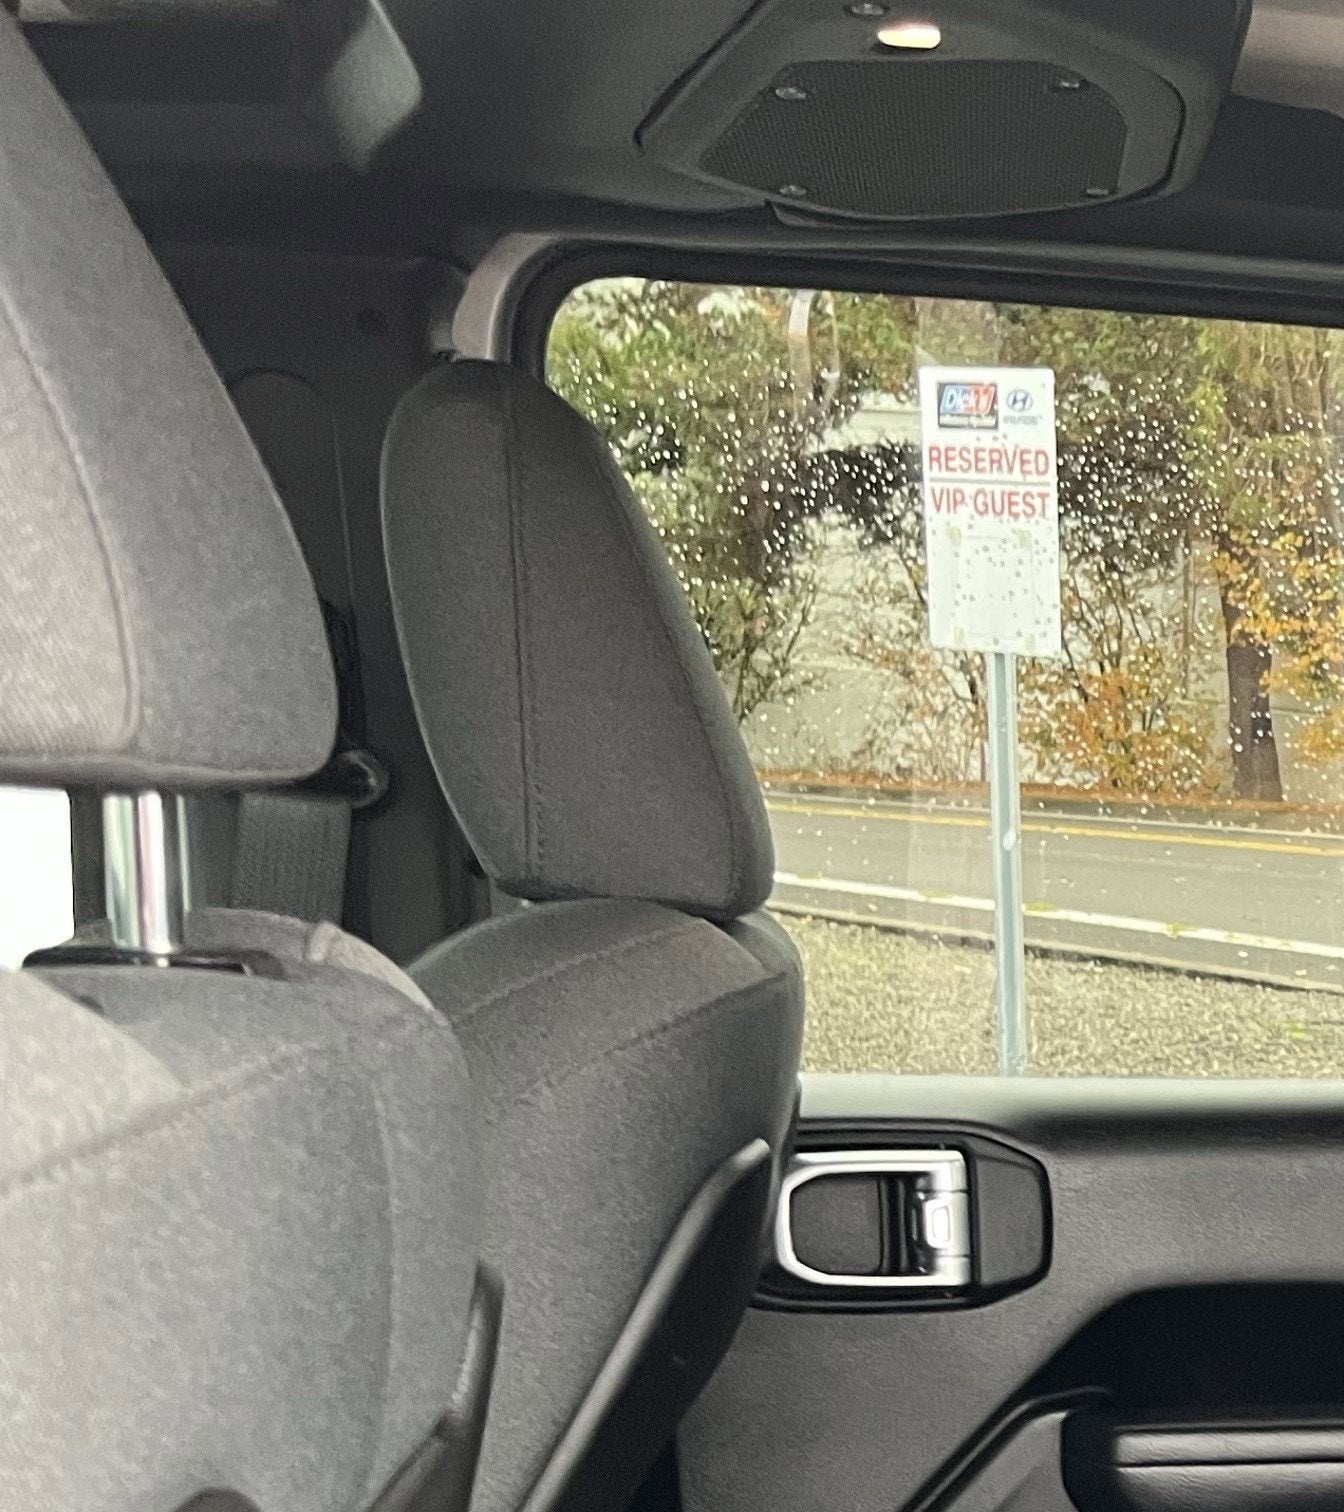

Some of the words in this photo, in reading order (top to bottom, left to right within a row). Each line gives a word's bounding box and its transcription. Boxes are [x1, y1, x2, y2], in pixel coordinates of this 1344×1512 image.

[928, 444, 1050, 477] RESERVED
[930, 486, 966, 514] VIP
[973, 486, 1050, 519] GUEST
